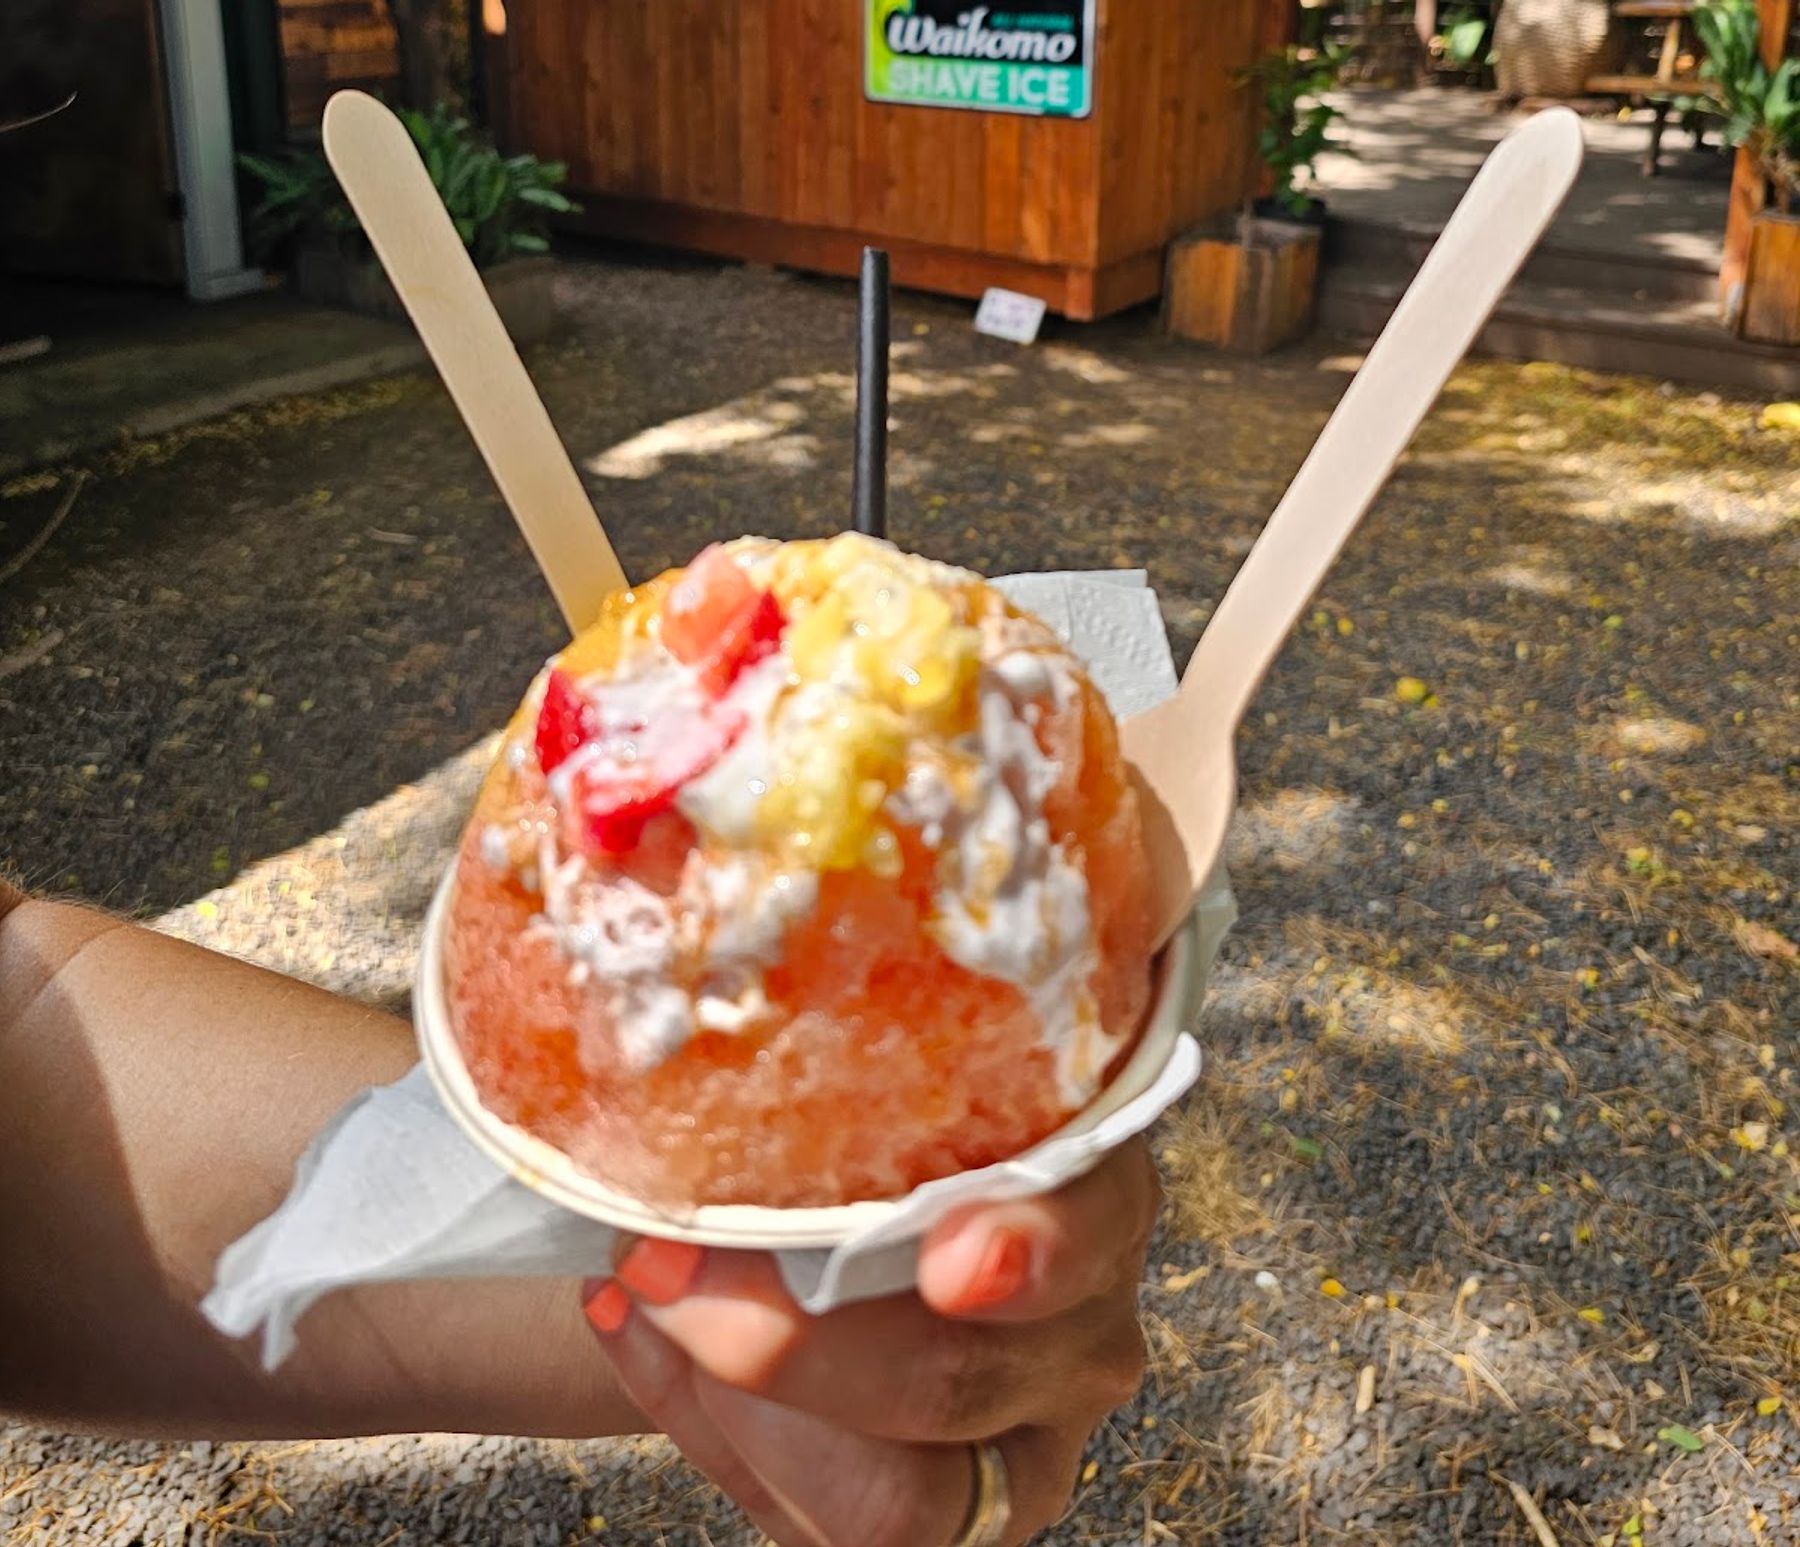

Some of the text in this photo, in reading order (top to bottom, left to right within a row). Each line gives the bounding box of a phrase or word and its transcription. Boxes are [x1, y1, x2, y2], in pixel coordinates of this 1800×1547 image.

[887, 6, 1077, 62] Waikomo
[889, 60, 1070, 106] SHAVE ICE
